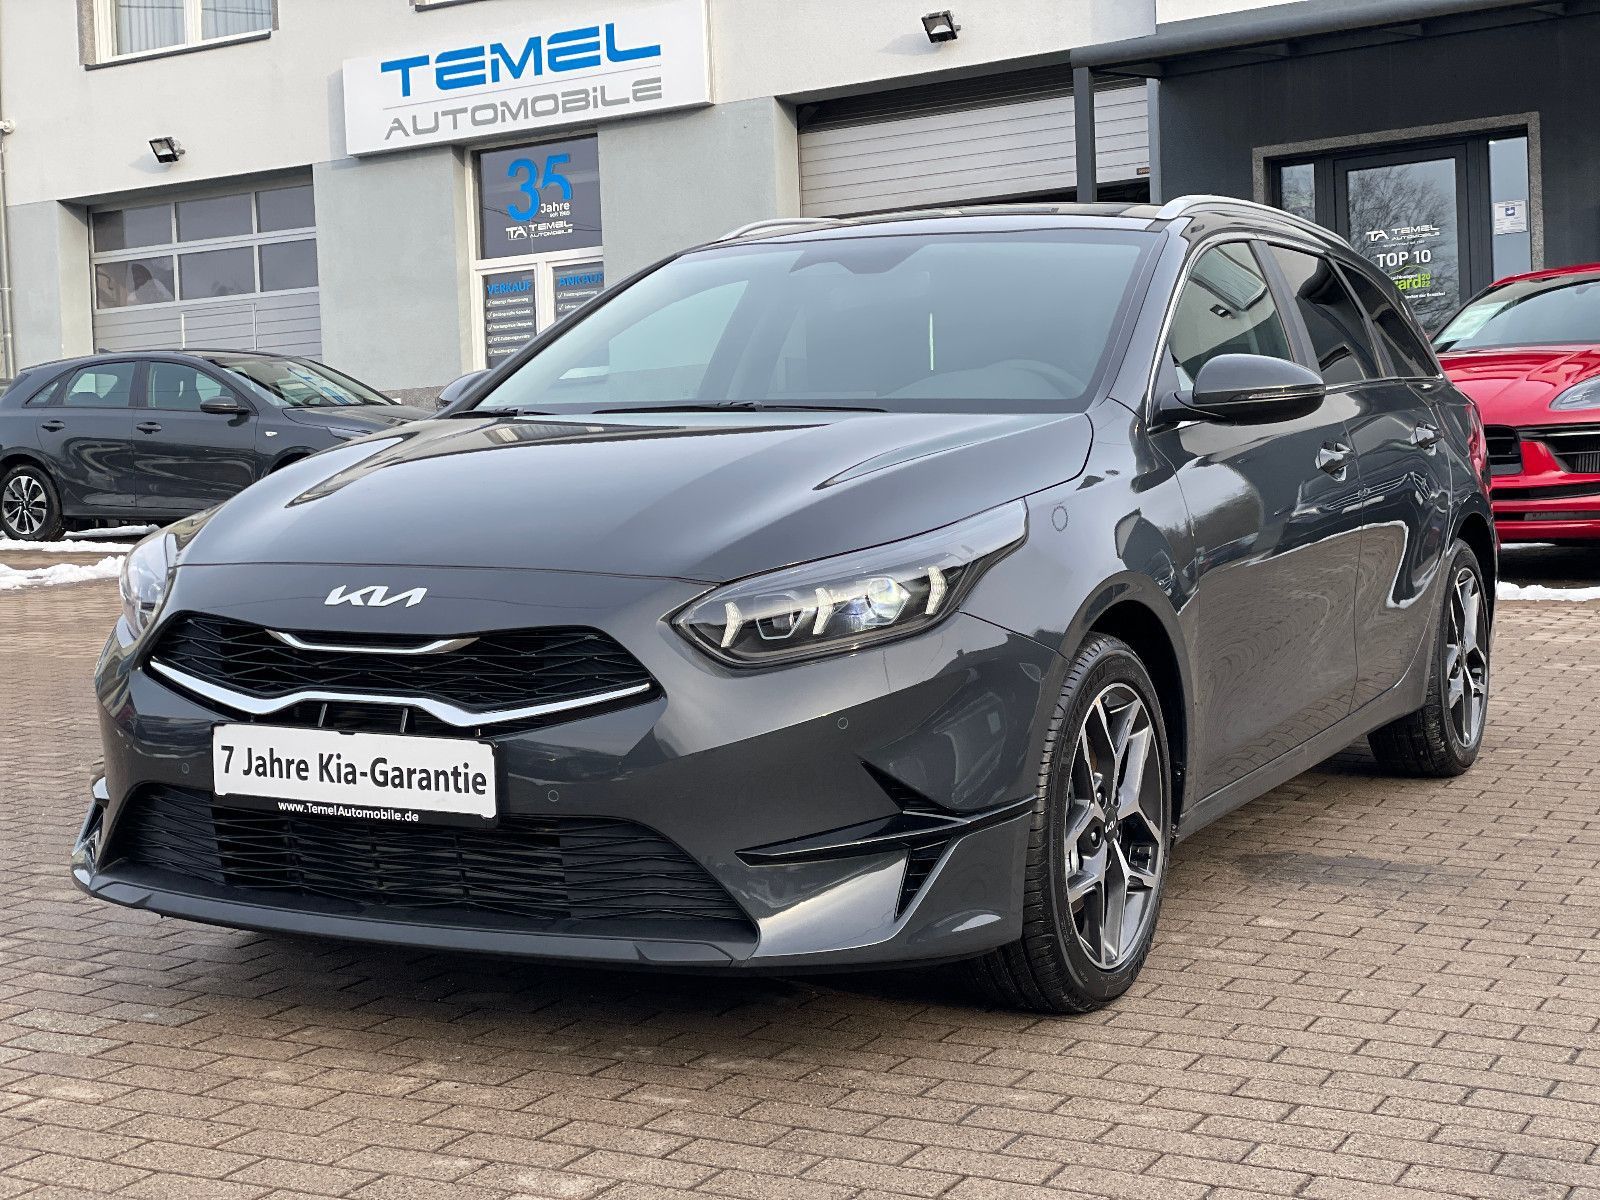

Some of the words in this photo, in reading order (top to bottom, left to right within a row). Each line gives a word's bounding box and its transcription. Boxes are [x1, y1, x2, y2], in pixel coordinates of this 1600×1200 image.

[381, 22, 661, 97] TEMEL
[507, 153, 573, 222] 35
[540, 201, 570, 213] Jahre
[529, 220, 573, 232] TEMEL
[1391, 224, 1440, 235] TEMEL
[1377, 252, 1409, 268] TOP
[1413, 250, 1431, 263] 10
[559, 271, 604, 287] ANKAUF
[1421, 273, 1431, 281] 20
[487, 280, 531, 295] VERKAUF
[324, 584, 428, 608] KIA
[220, 745, 235, 774] 7
[242, 747, 310, 781] Jahre
[318, 752, 487, 795] Kia-Garantie
[278, 801, 419, 822] www.TemelAutomobile.de
